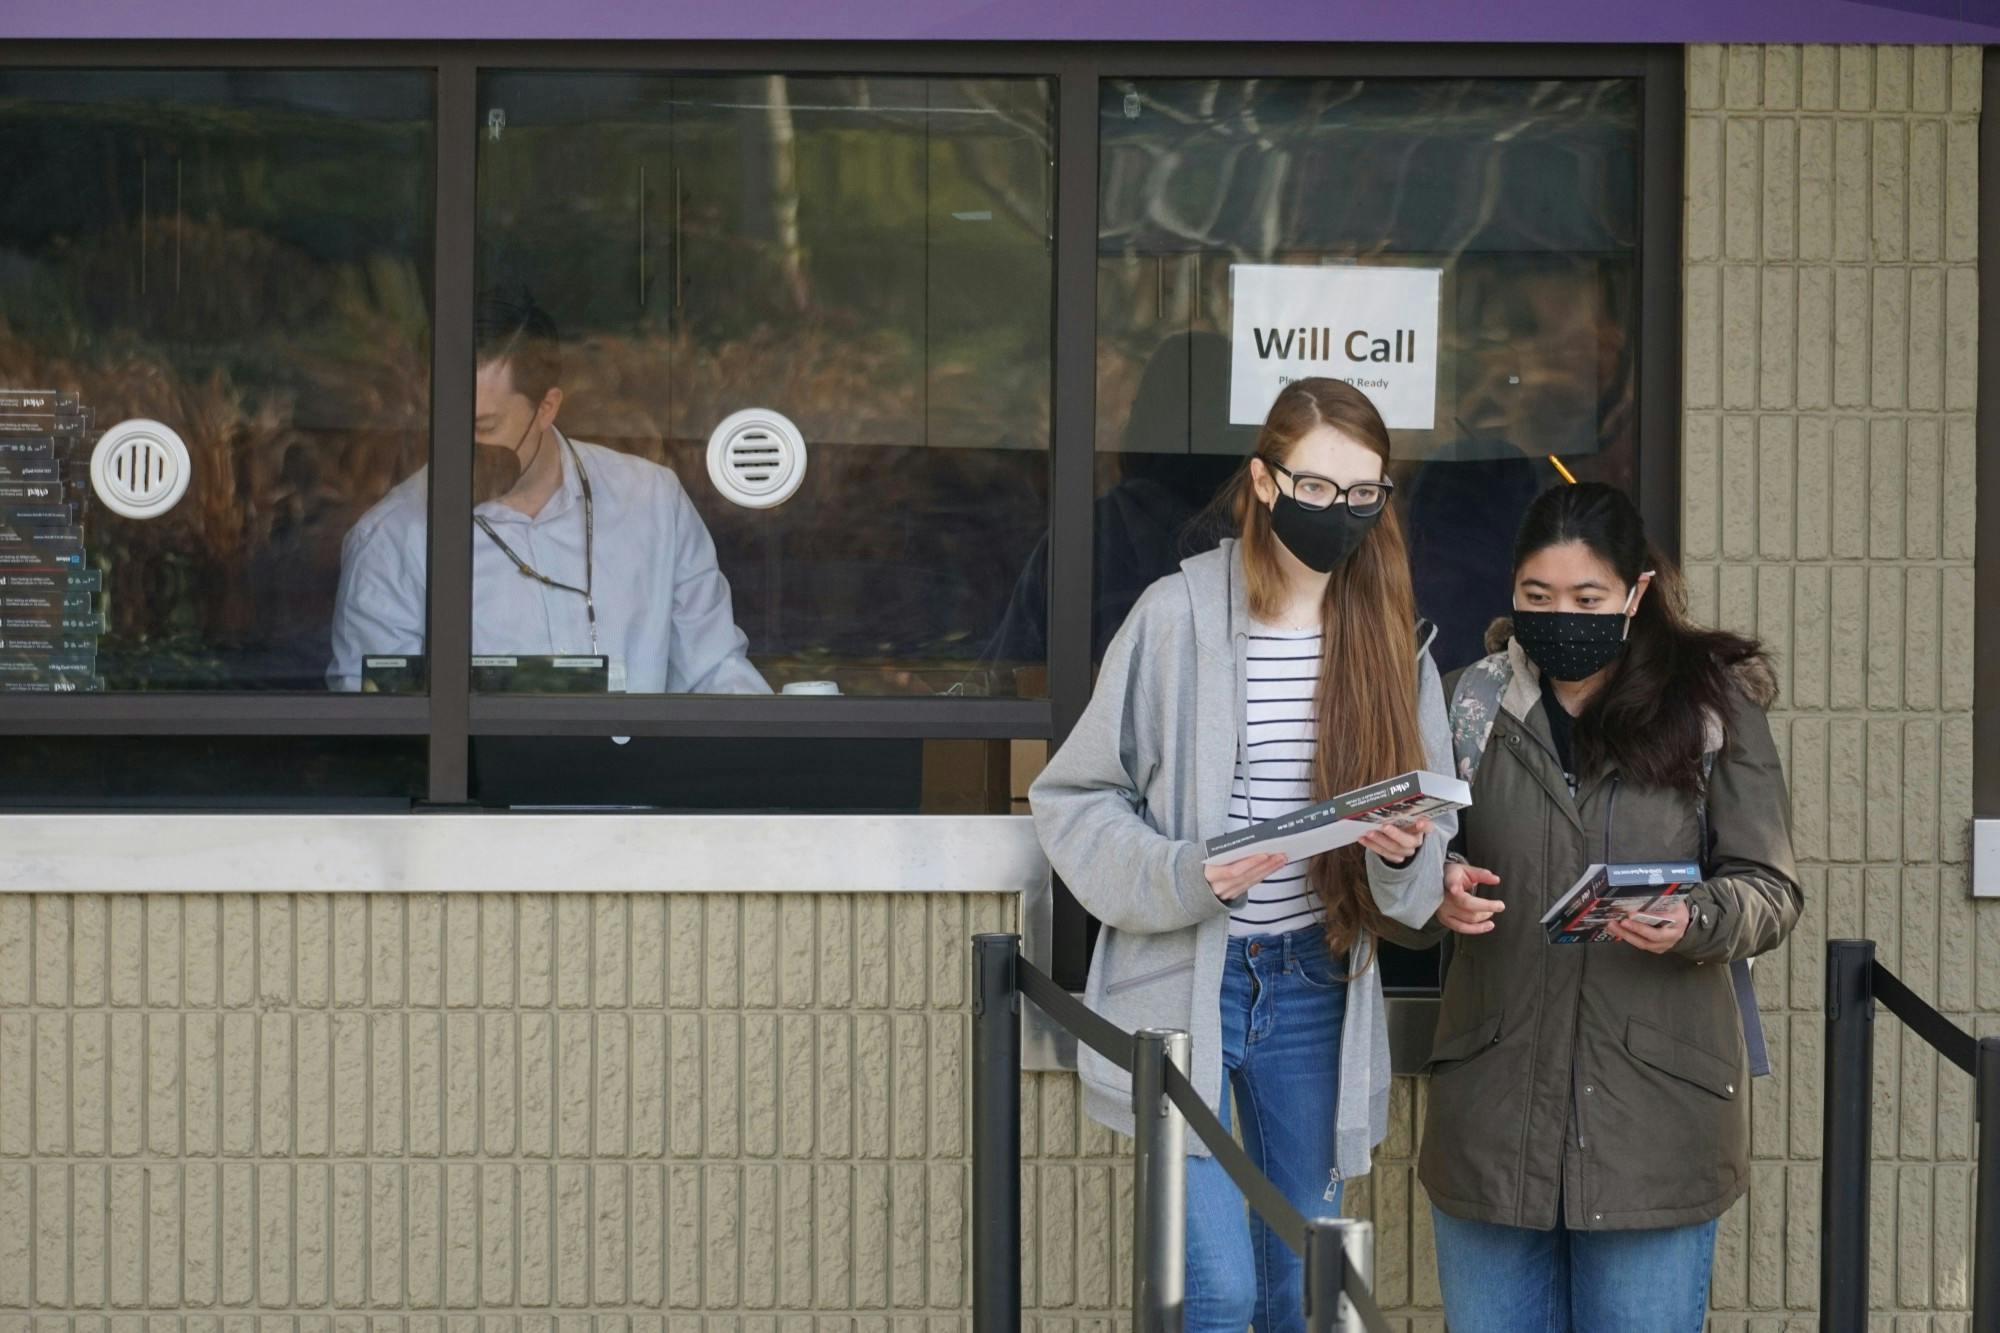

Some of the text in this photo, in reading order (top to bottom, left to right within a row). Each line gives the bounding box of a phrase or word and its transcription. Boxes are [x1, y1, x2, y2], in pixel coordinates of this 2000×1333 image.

[1253, 327, 1415, 363] Will Call
[1357, 378, 1389, 390] Ready
[1390, 781, 1410, 795] eMed
